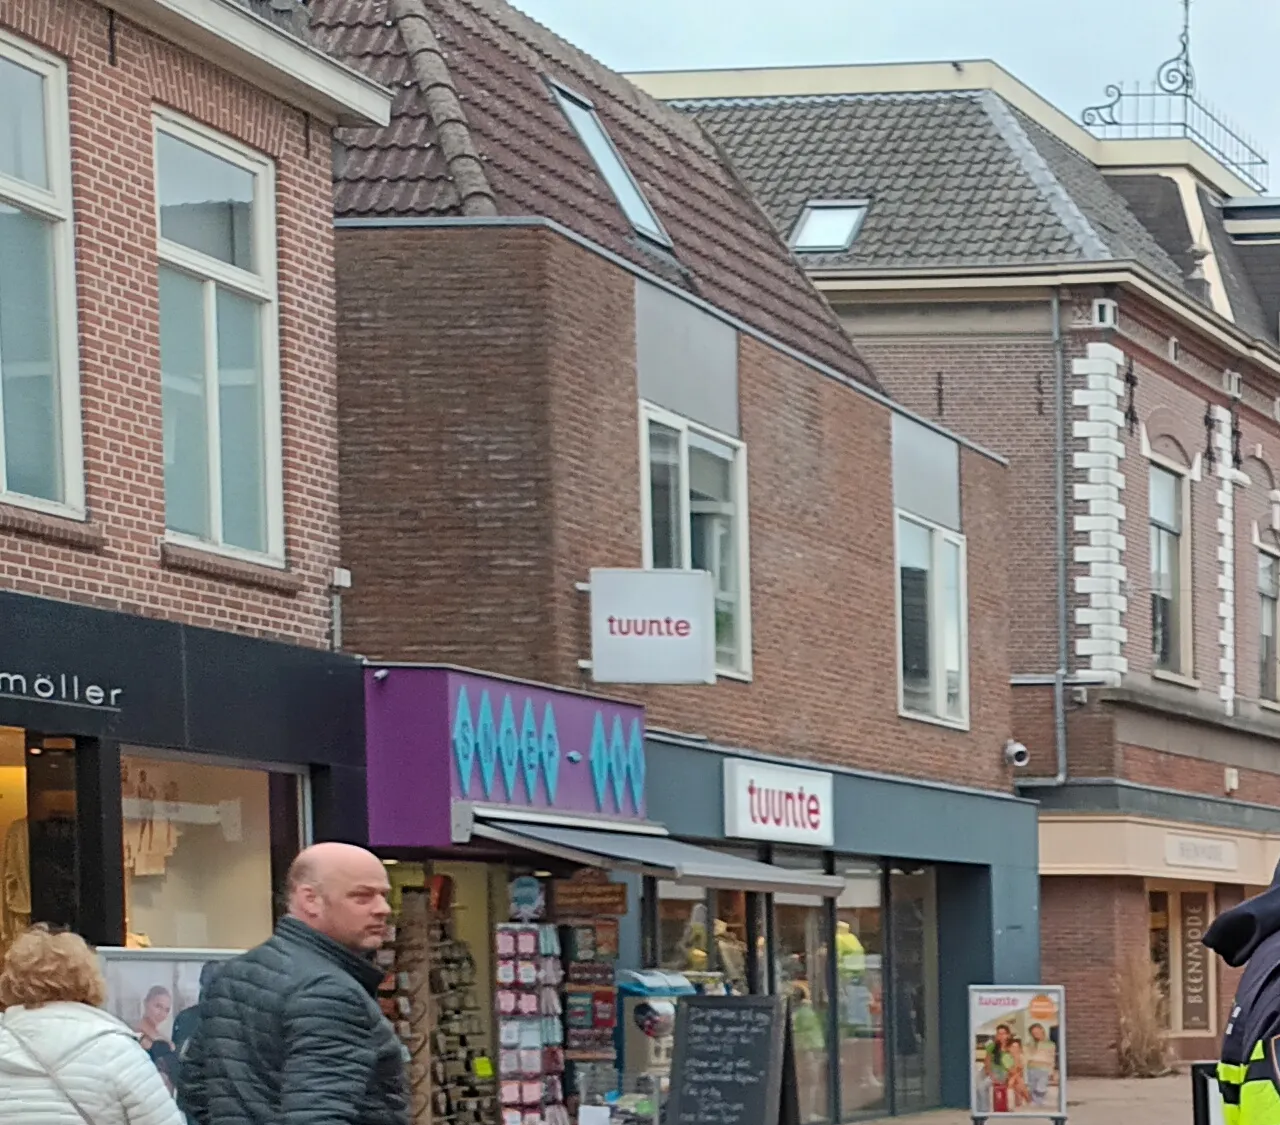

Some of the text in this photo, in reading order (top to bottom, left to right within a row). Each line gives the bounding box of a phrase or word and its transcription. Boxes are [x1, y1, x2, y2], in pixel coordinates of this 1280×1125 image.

[607, 615, 691, 637] tuunte
[747, 779, 821, 831] tuunte
[1186, 905, 1204, 1004] BEENMODE
